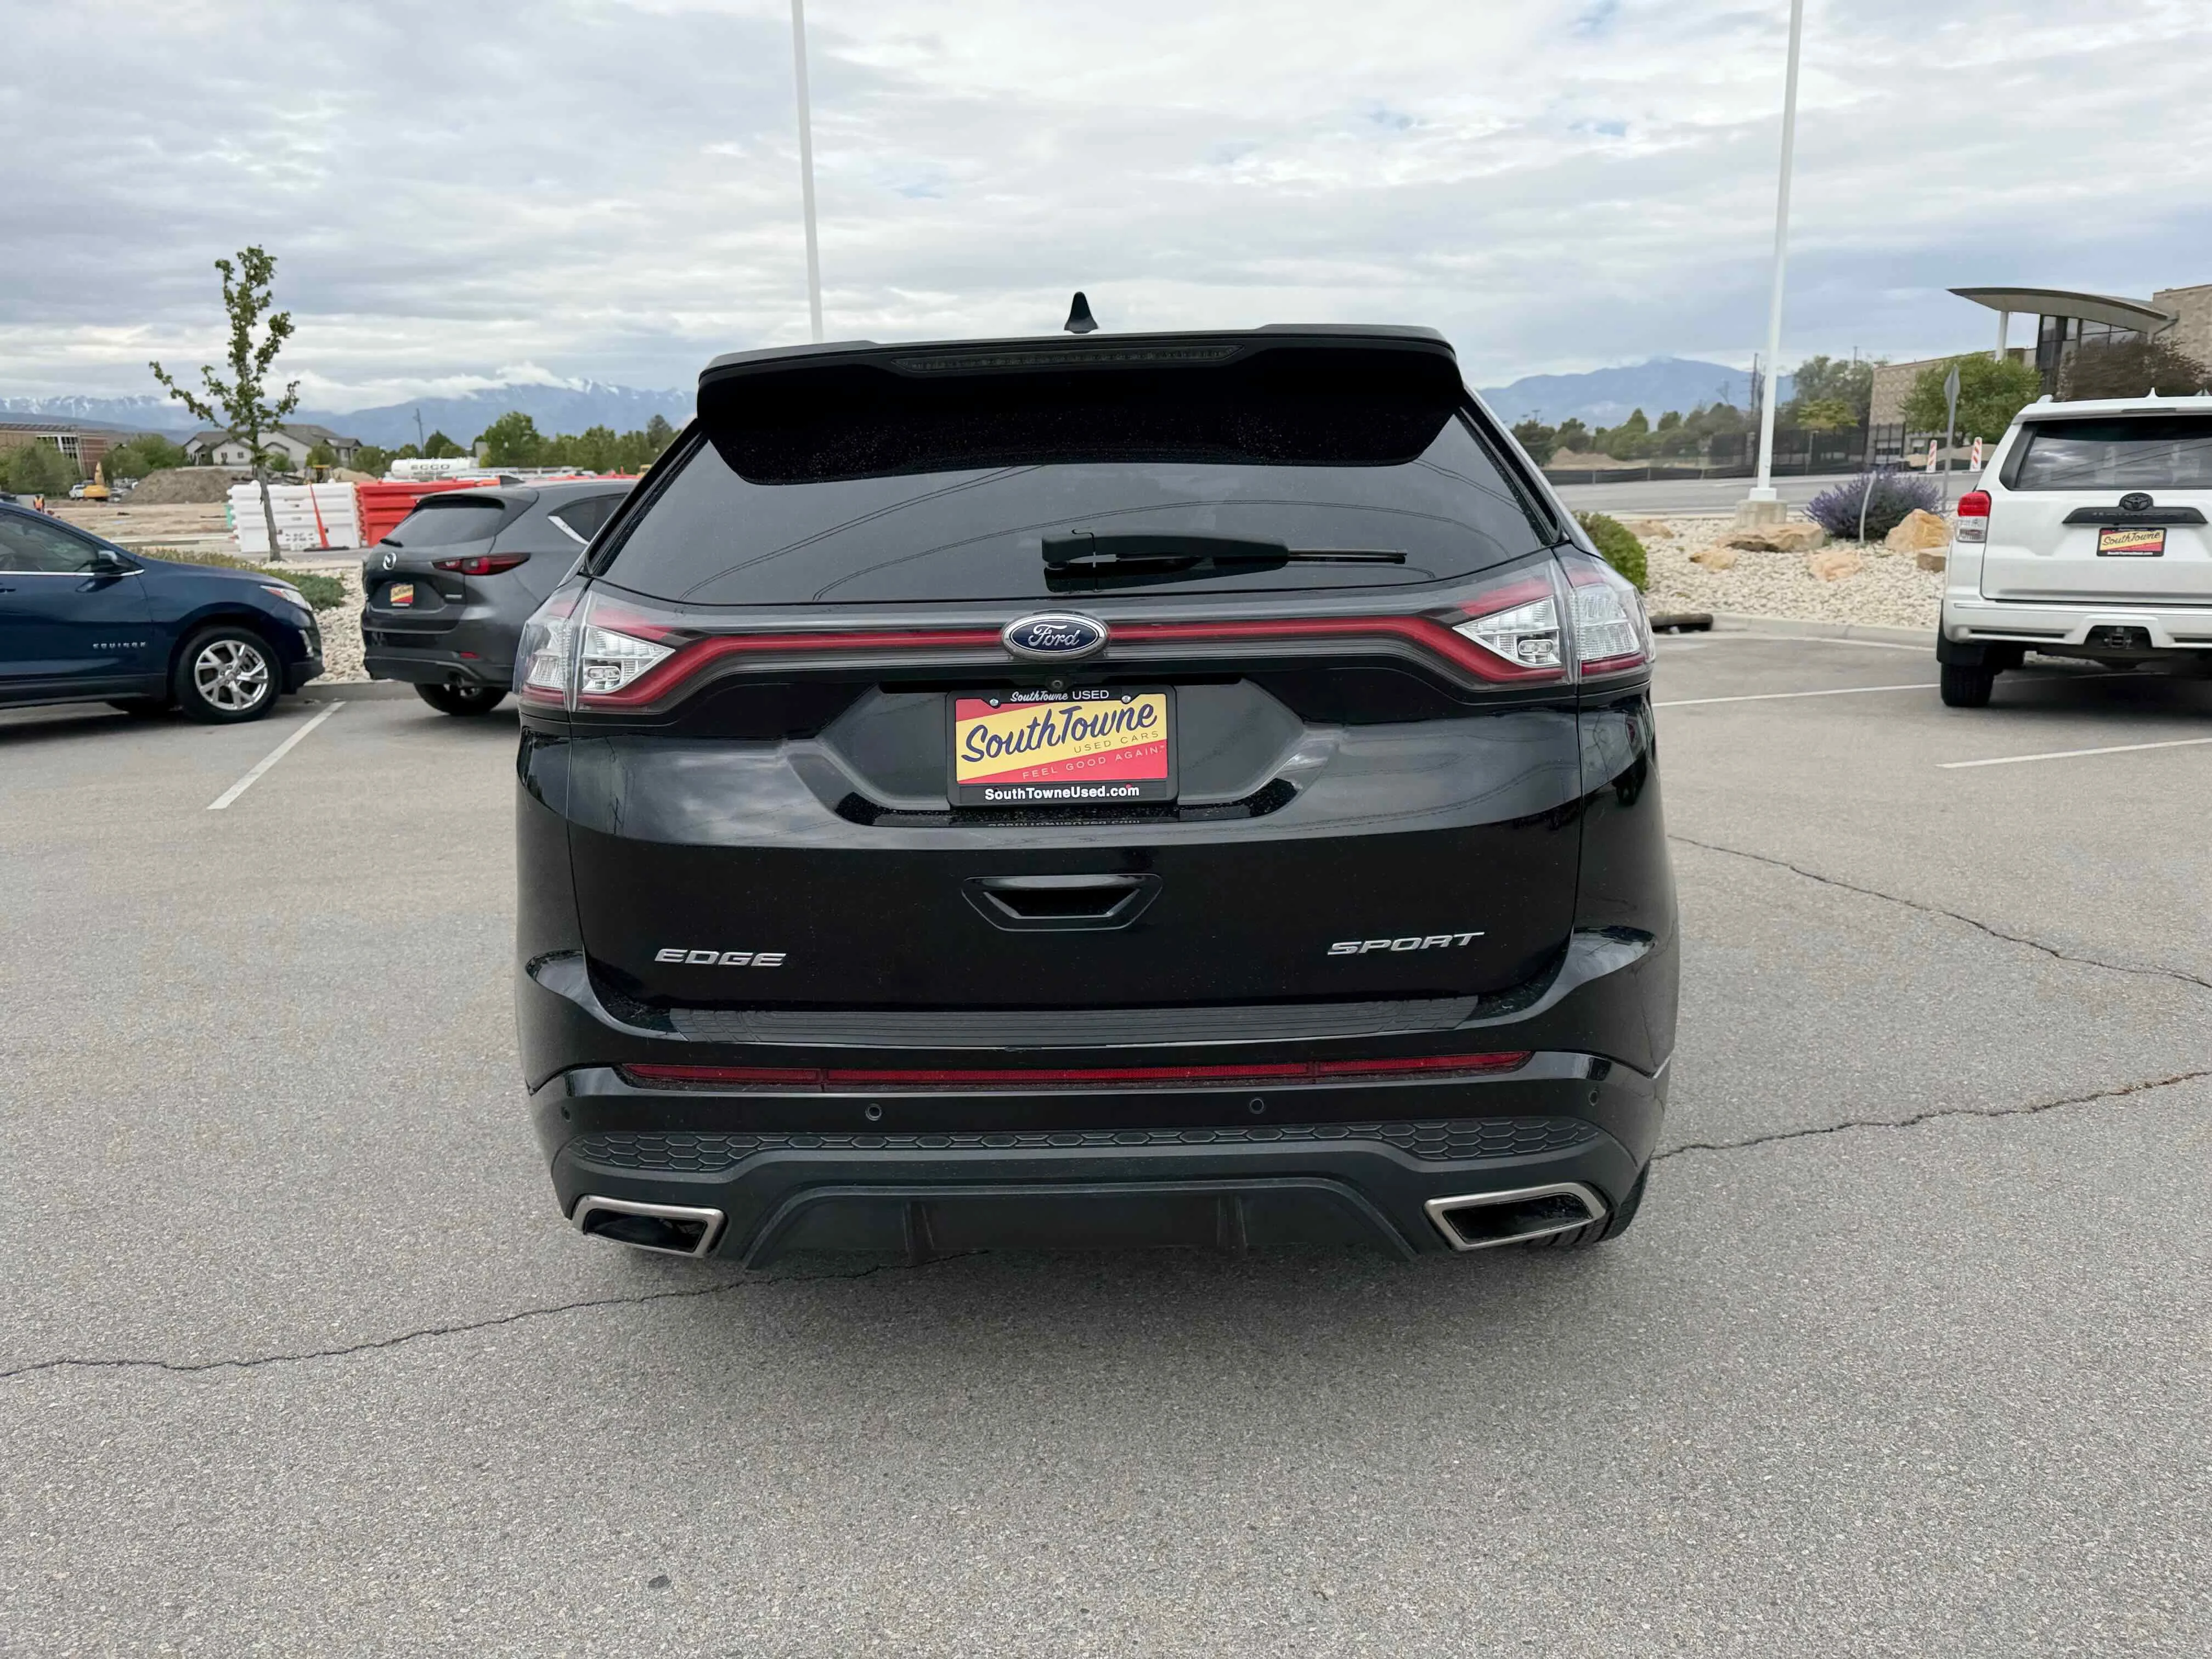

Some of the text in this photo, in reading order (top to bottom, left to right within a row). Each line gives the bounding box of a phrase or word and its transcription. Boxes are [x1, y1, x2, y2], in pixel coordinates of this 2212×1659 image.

[2102, 532, 2161, 545] SouthTowne
[1028, 624, 1081, 646] Ford
[1010, 690, 1109, 702] SouthTowne USED
[961, 703, 1158, 763] SouthTowne
[1074, 730, 1159, 754] USED CARS
[1022, 766, 1056, 780] FEEL
[1065, 757, 1106, 771] GOOD
[984, 785, 1140, 800] SouthTowneUsed.com
[1327, 932, 1485, 955] SPORT
[654, 948, 787, 967] EDGE
